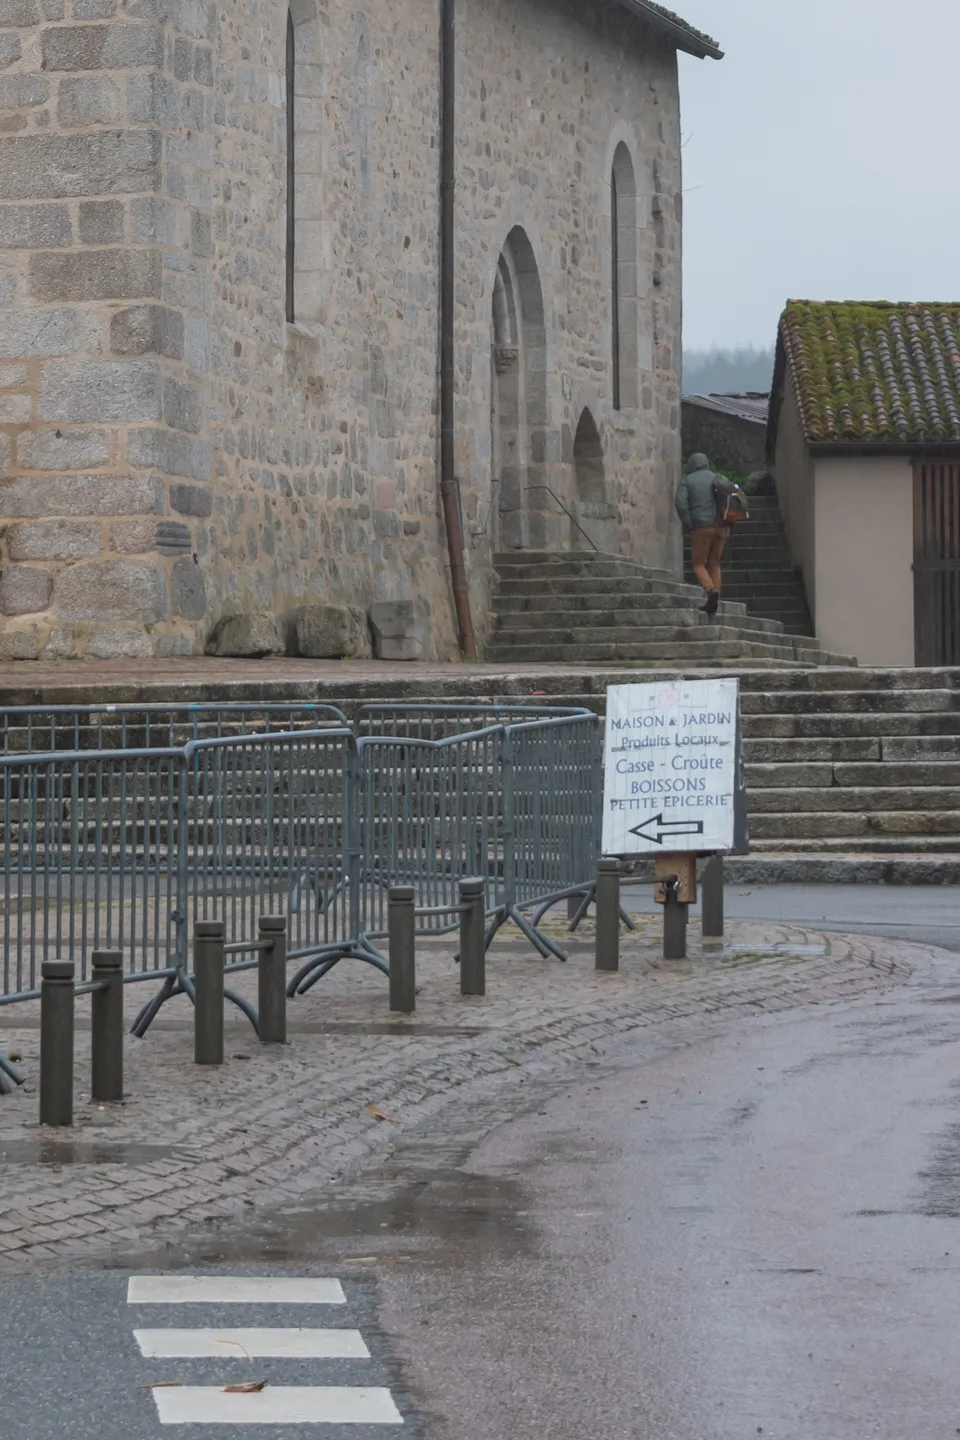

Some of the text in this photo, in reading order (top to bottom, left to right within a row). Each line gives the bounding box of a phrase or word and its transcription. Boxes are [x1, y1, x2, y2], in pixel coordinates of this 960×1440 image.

[611, 712, 732, 730] MAISON & JARDIN
[621, 733, 719, 750] Produits Locaux
[616, 758, 655, 774] Casse
[671, 754, 724, 770] Croûte
[631, 777, 706, 794] BOISSONS
[610, 794, 728, 811] PETITE EPICERIE
